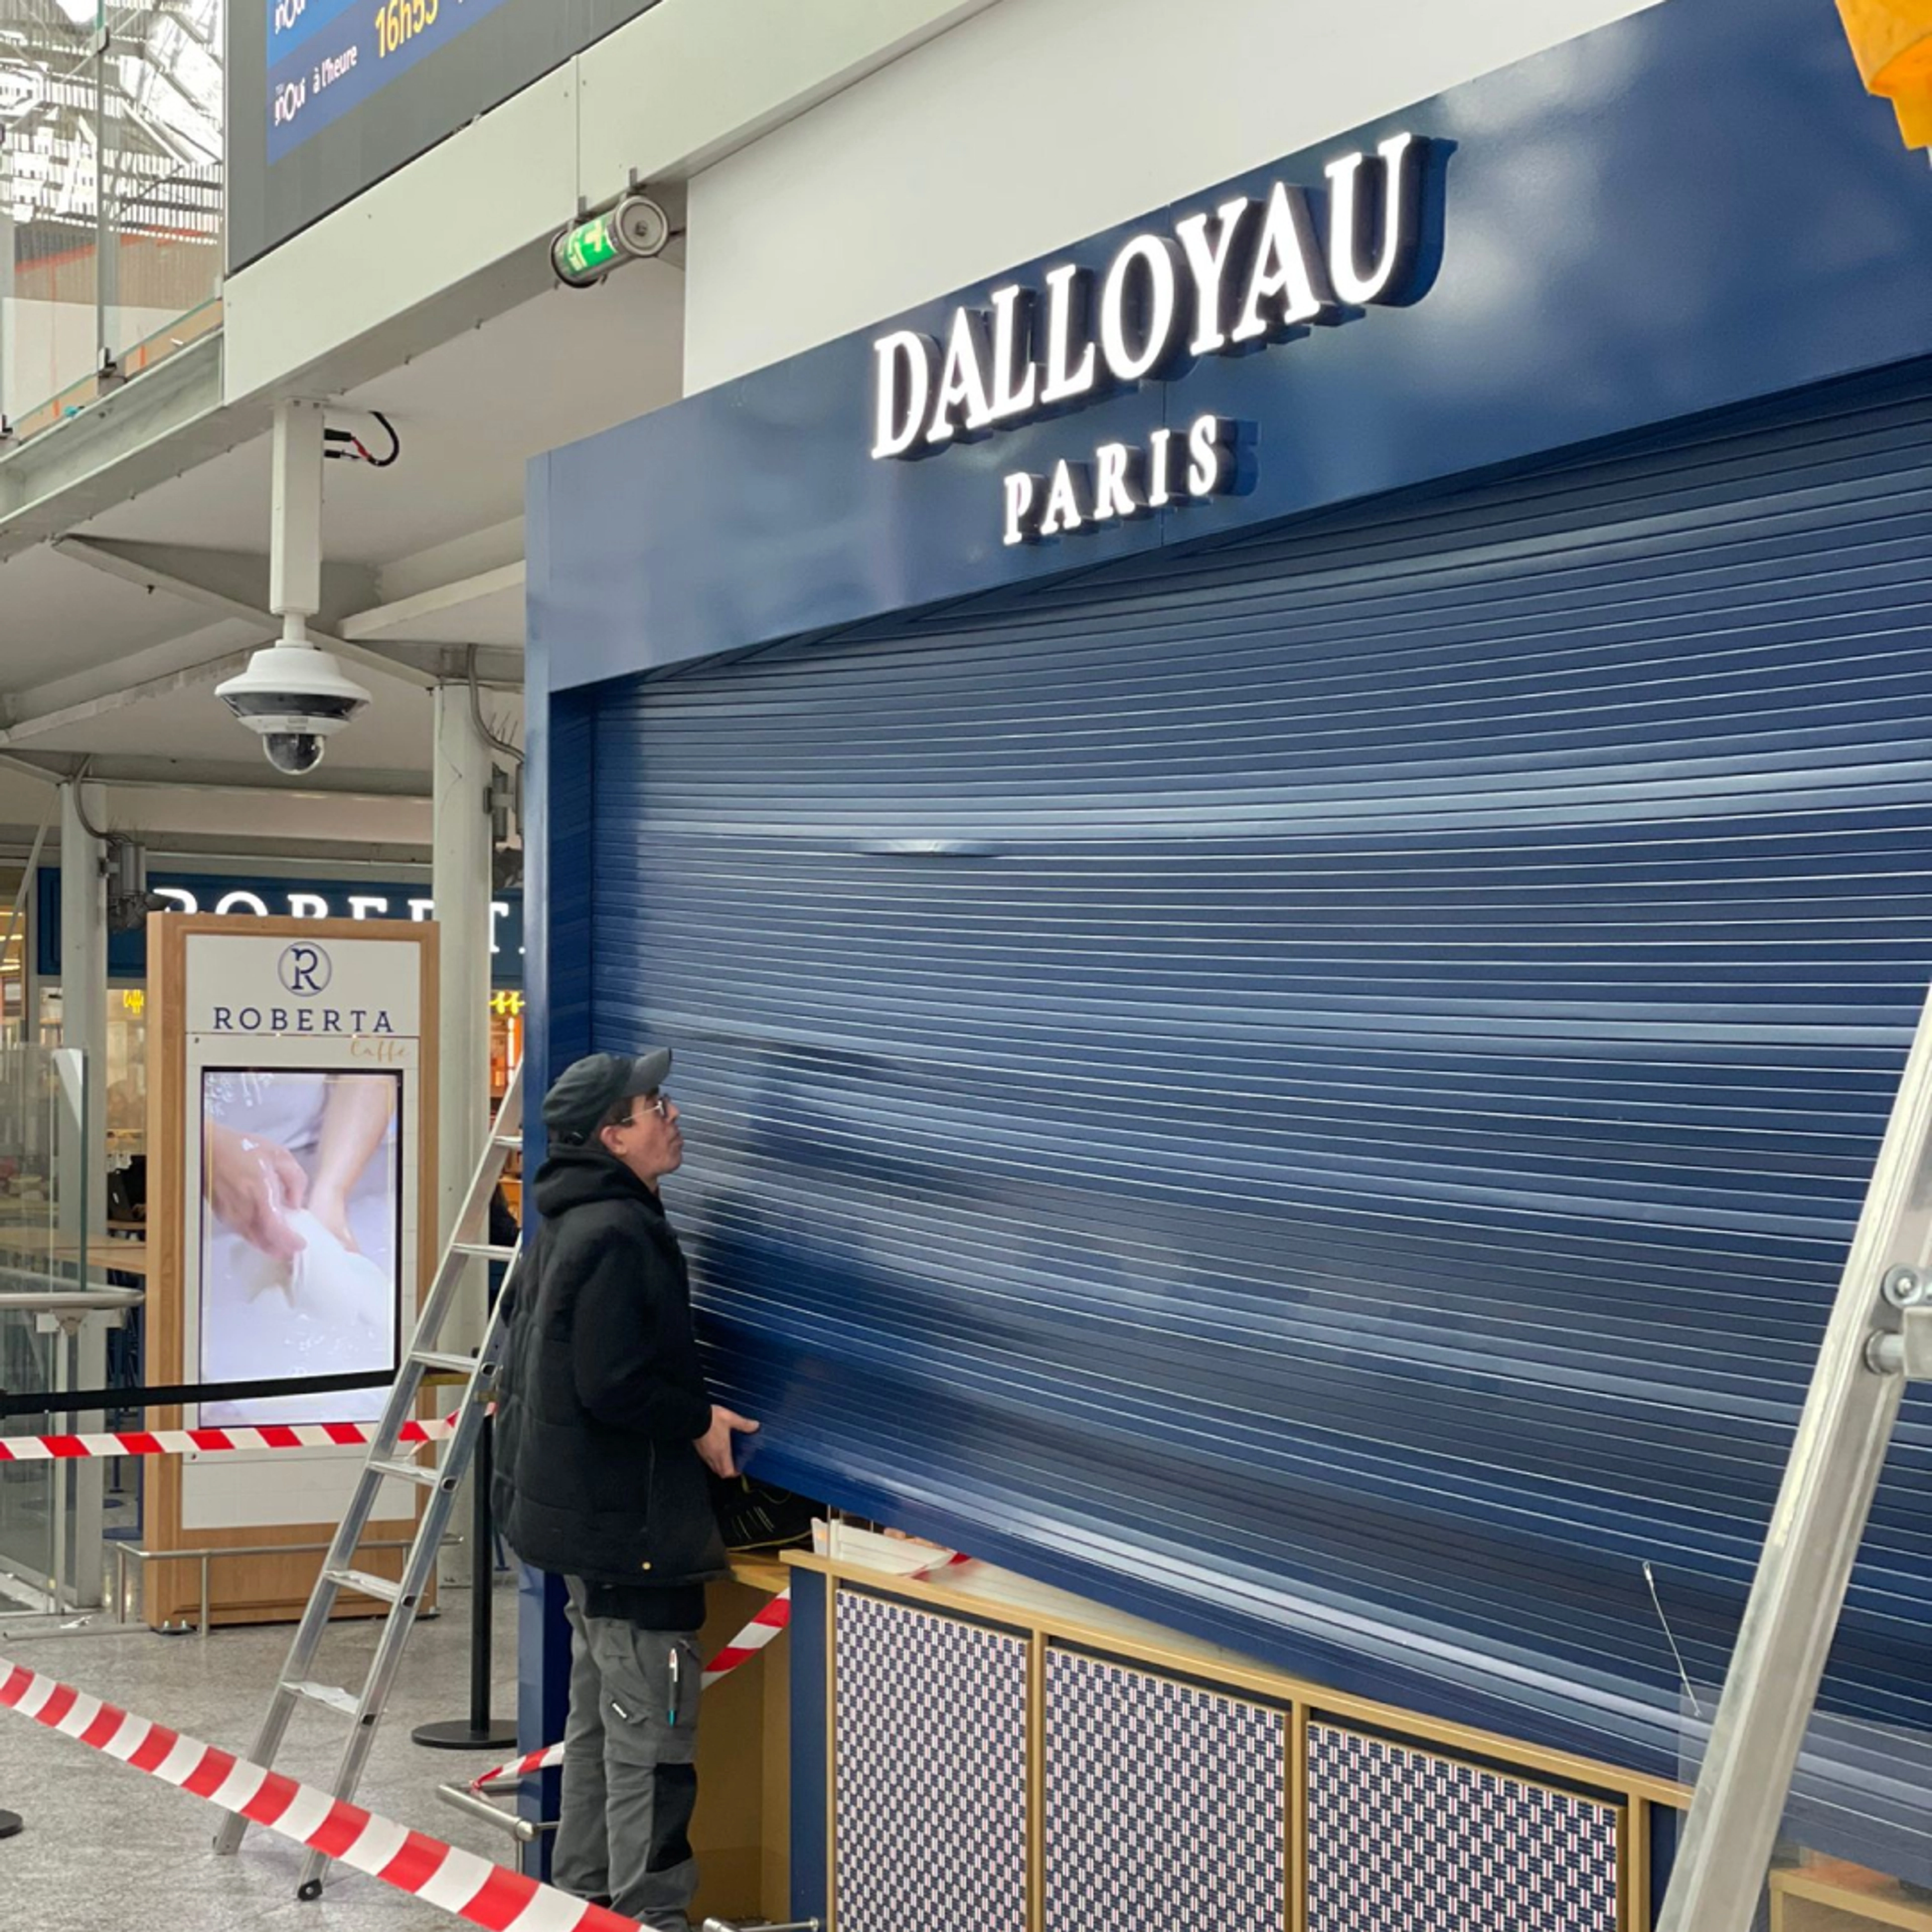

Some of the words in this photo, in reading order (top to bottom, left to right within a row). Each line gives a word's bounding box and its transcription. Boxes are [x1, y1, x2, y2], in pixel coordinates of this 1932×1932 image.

[313, 67, 320, 94] à
[321, 45, 357, 88] l'heure
[871, 132, 1412, 459] DALLOYAU
[1003, 415, 1218, 545] PARIS
[213, 1007, 393, 1032] ROBERTA
